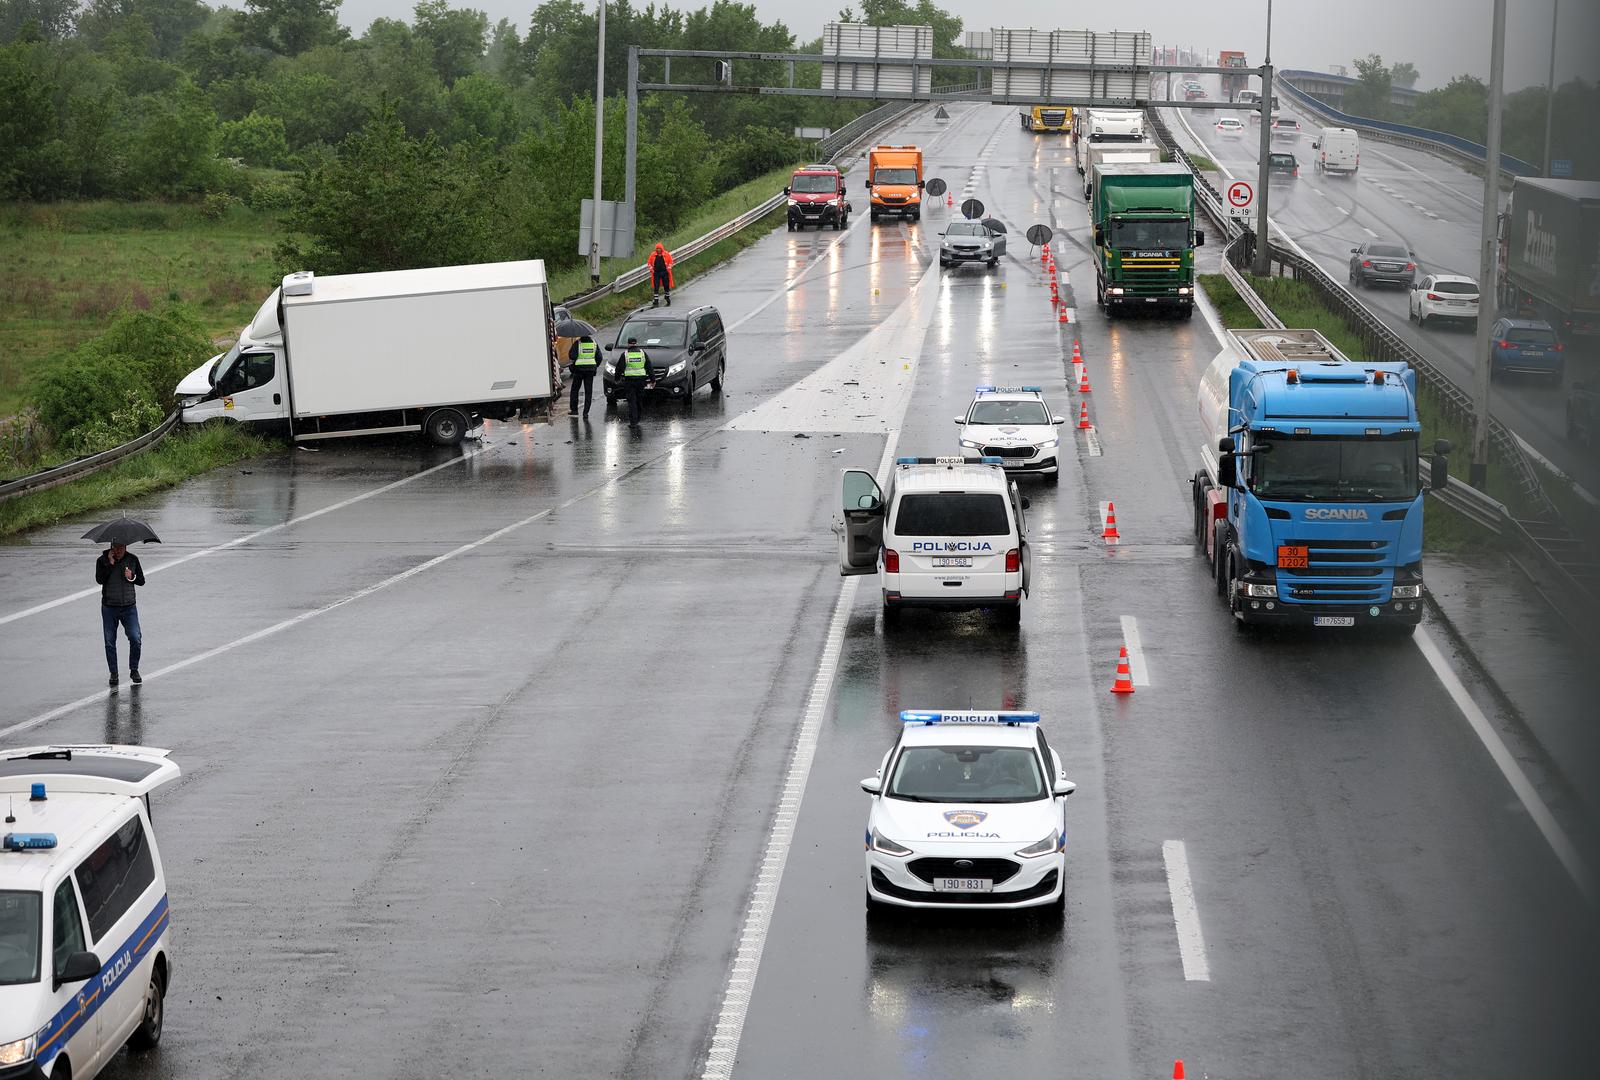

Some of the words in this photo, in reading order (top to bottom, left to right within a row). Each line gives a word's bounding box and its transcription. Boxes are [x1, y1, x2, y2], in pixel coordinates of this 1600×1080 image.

[1305, 508, 1368, 520] SCANIA
[1287, 547, 1298, 556] 30
[1281, 558, 1305, 567] 1202
[943, 879, 959, 889] 190
[967, 879, 983, 889] 831
[101, 950, 132, 992] POLICIJA
